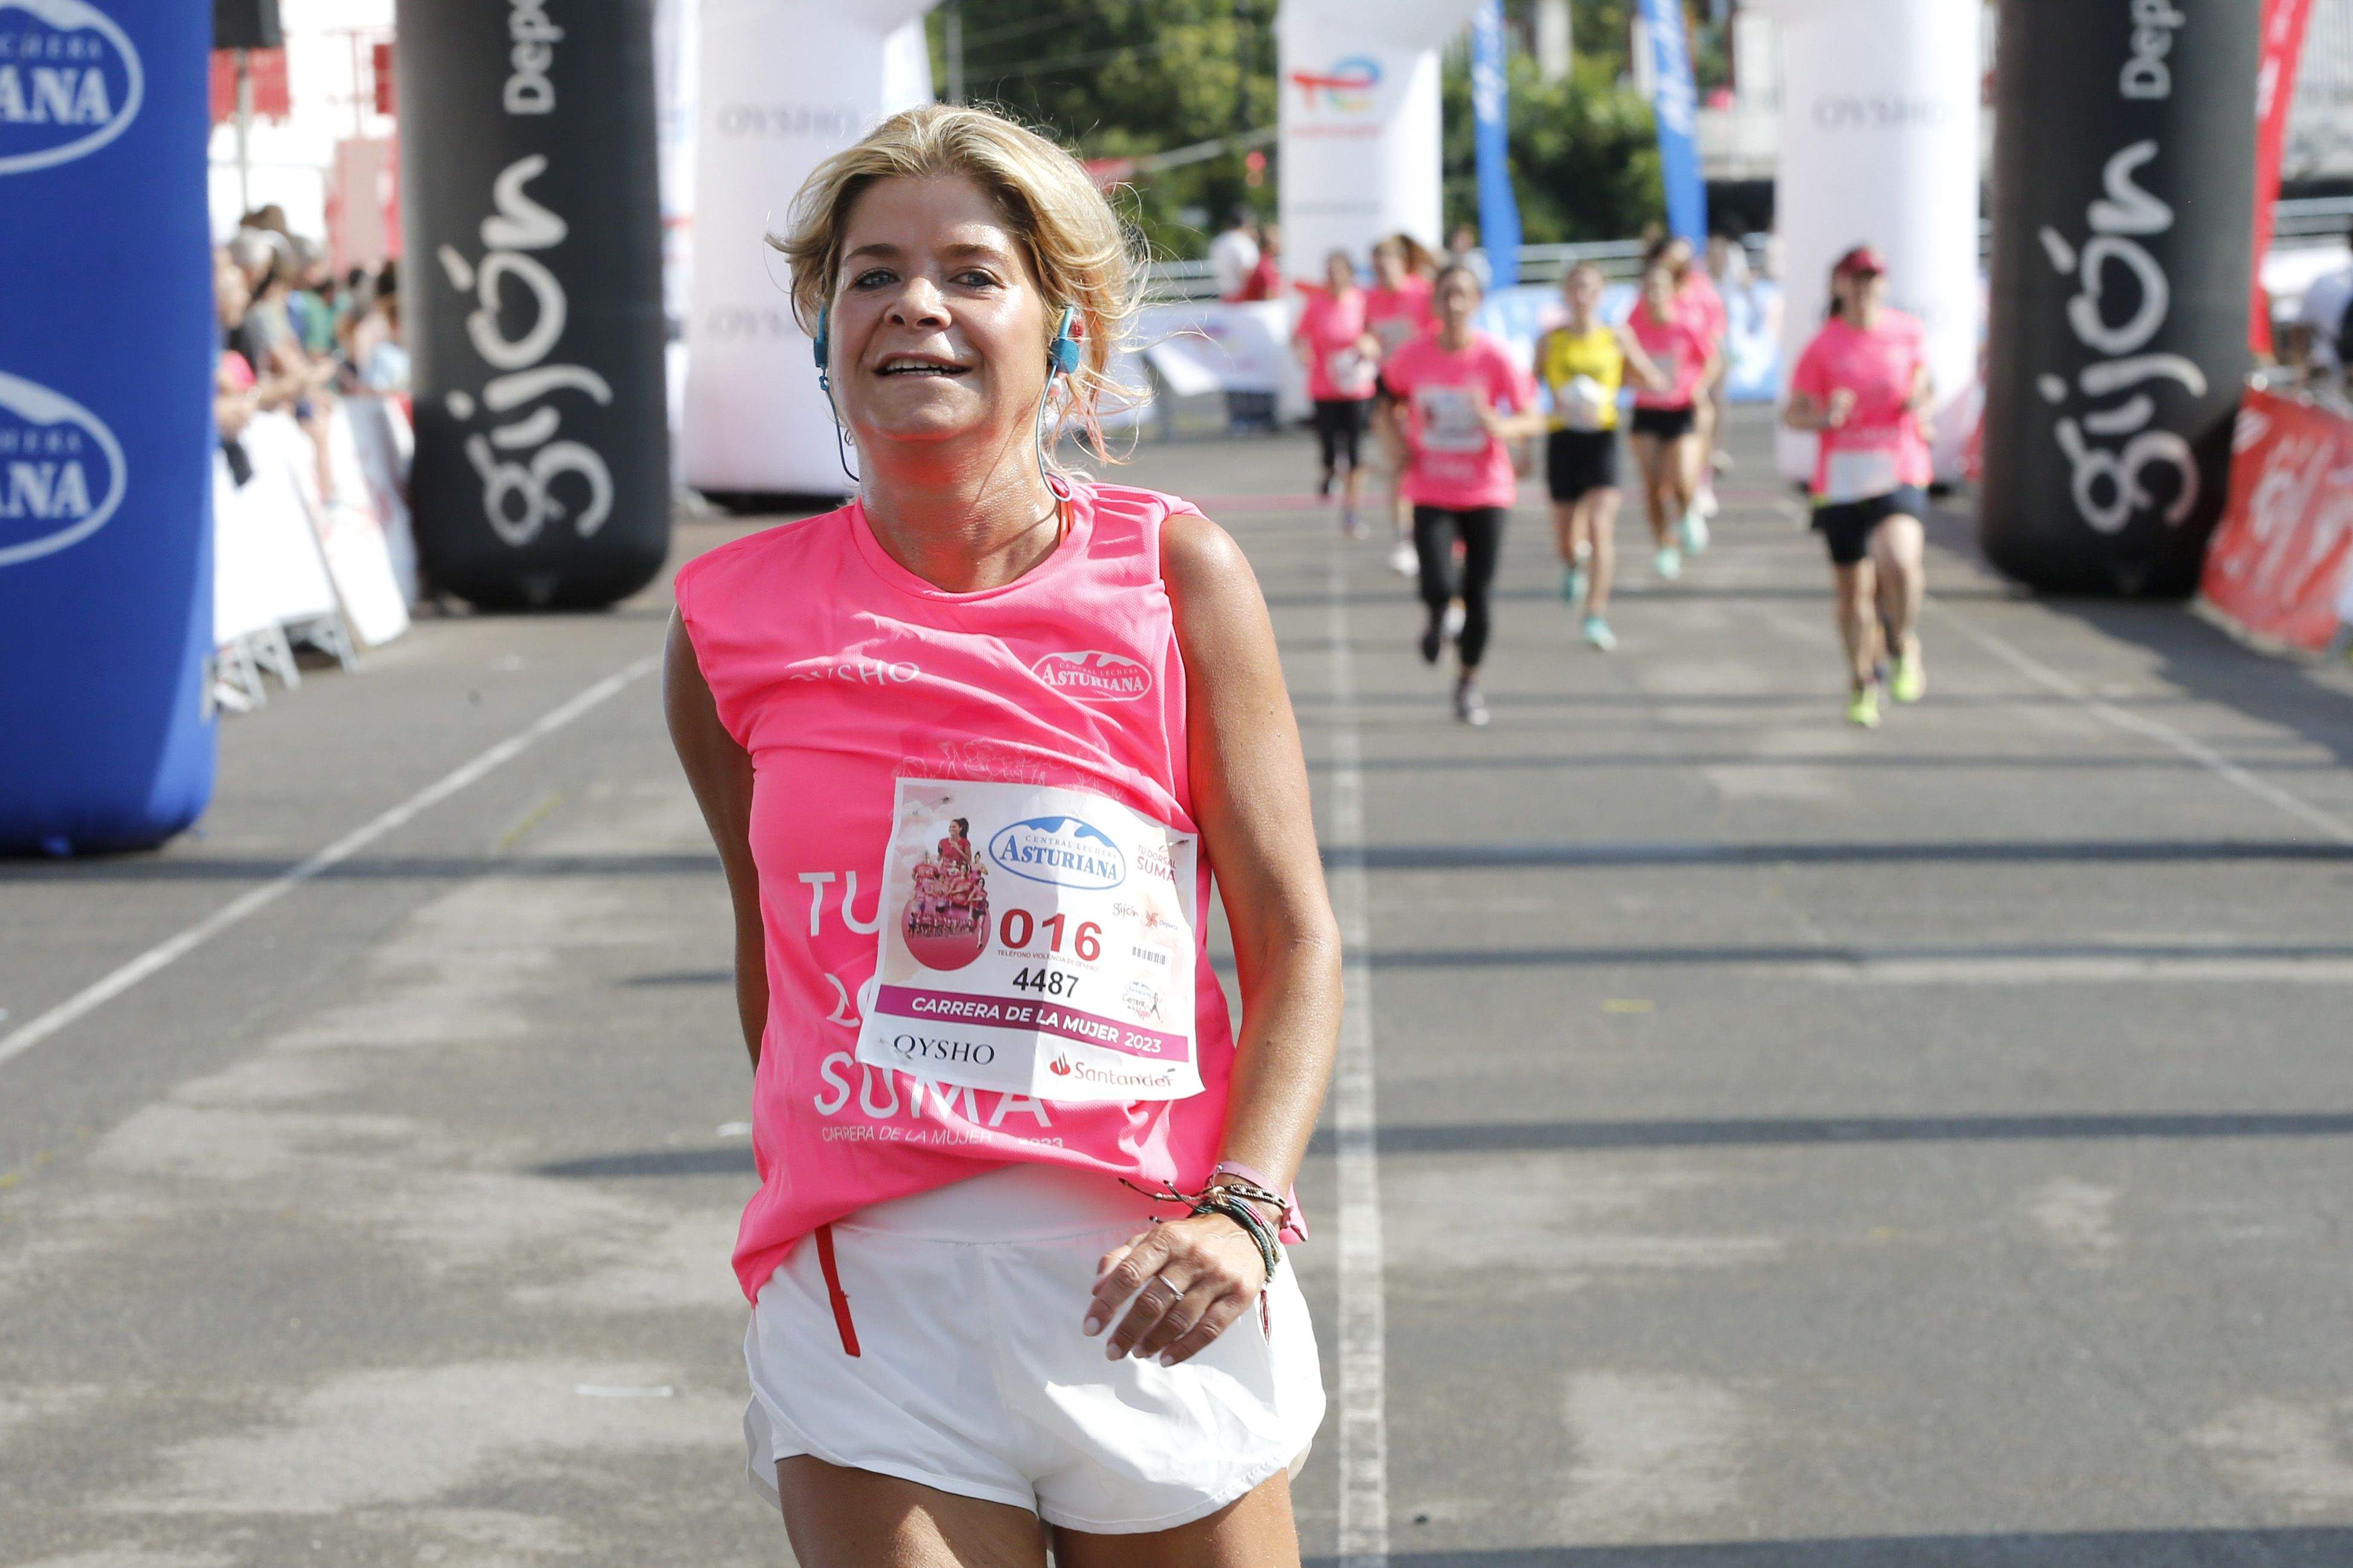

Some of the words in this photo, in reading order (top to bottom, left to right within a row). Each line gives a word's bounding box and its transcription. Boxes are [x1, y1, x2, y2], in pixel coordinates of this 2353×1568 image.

[438, 154, 613, 545] gijón
[2037, 139, 2207, 533] gijón
[1042, 663, 1145, 692] ASTURIANA
[1025, 835, 1072, 848] CENTRAL
[1000, 834, 1117, 881] ASTURIANA
[1137, 856, 1176, 885] SUMA
[1000, 908, 1102, 962] 016
[1013, 967, 1079, 998] 4487
[912, 997, 1001, 1020] CARRERA
[1004, 1005, 1033, 1023] DE
[1036, 1008, 1059, 1028] LA
[1062, 1016, 1120, 1044] MUJER
[1124, 1032, 1163, 1054] 2023
[1074, 1061, 1174, 1087] Santander
[822, 1126, 875, 1142] CARRERA
[879, 1125, 901, 1141] DE
